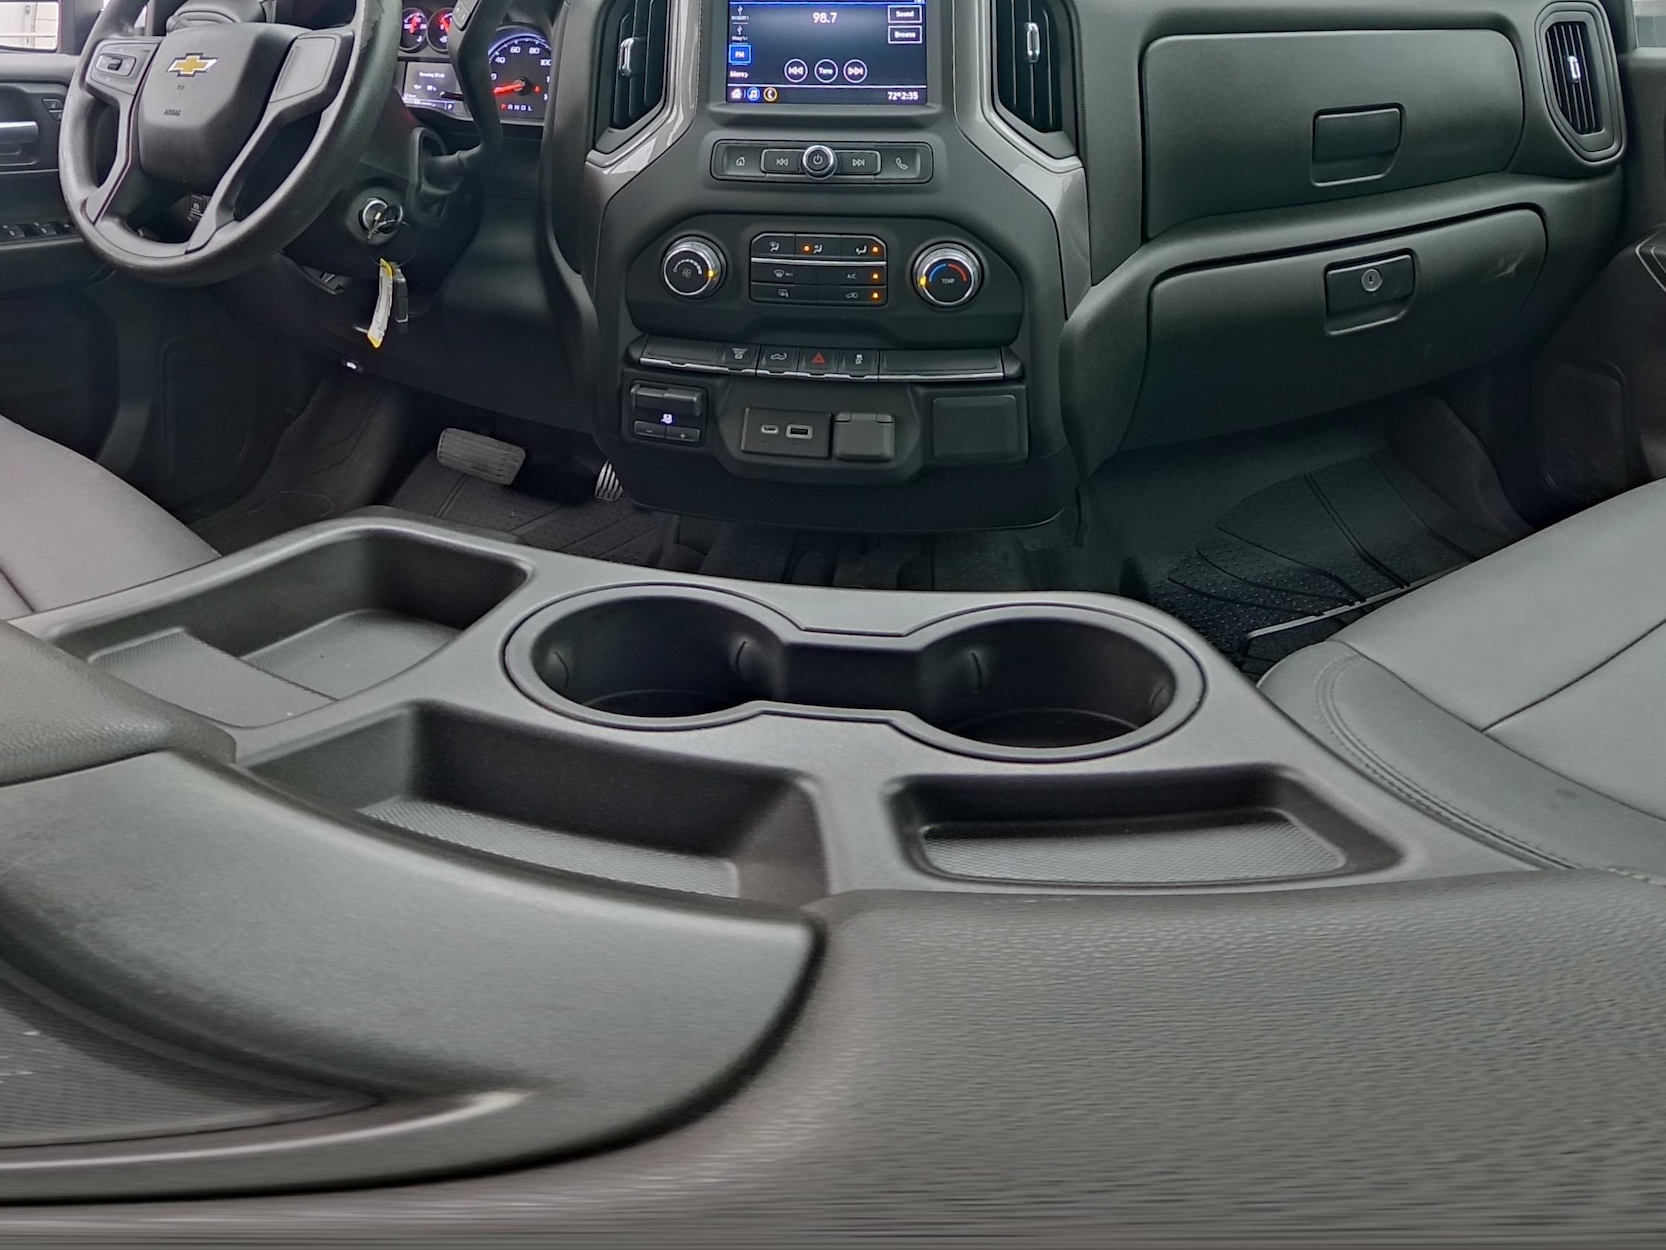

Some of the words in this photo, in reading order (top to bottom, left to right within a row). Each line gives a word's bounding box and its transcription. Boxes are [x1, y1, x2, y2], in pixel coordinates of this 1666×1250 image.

[813, 12, 837, 23] 98.7
[896, 10, 914, 18] Sound
[894, 31, 916, 39] Browse
[510, 46, 521, 54] 60
[529, 47, 540, 55] 80
[495, 56, 506, 64] 40
[818, 67, 833, 75] Tune
